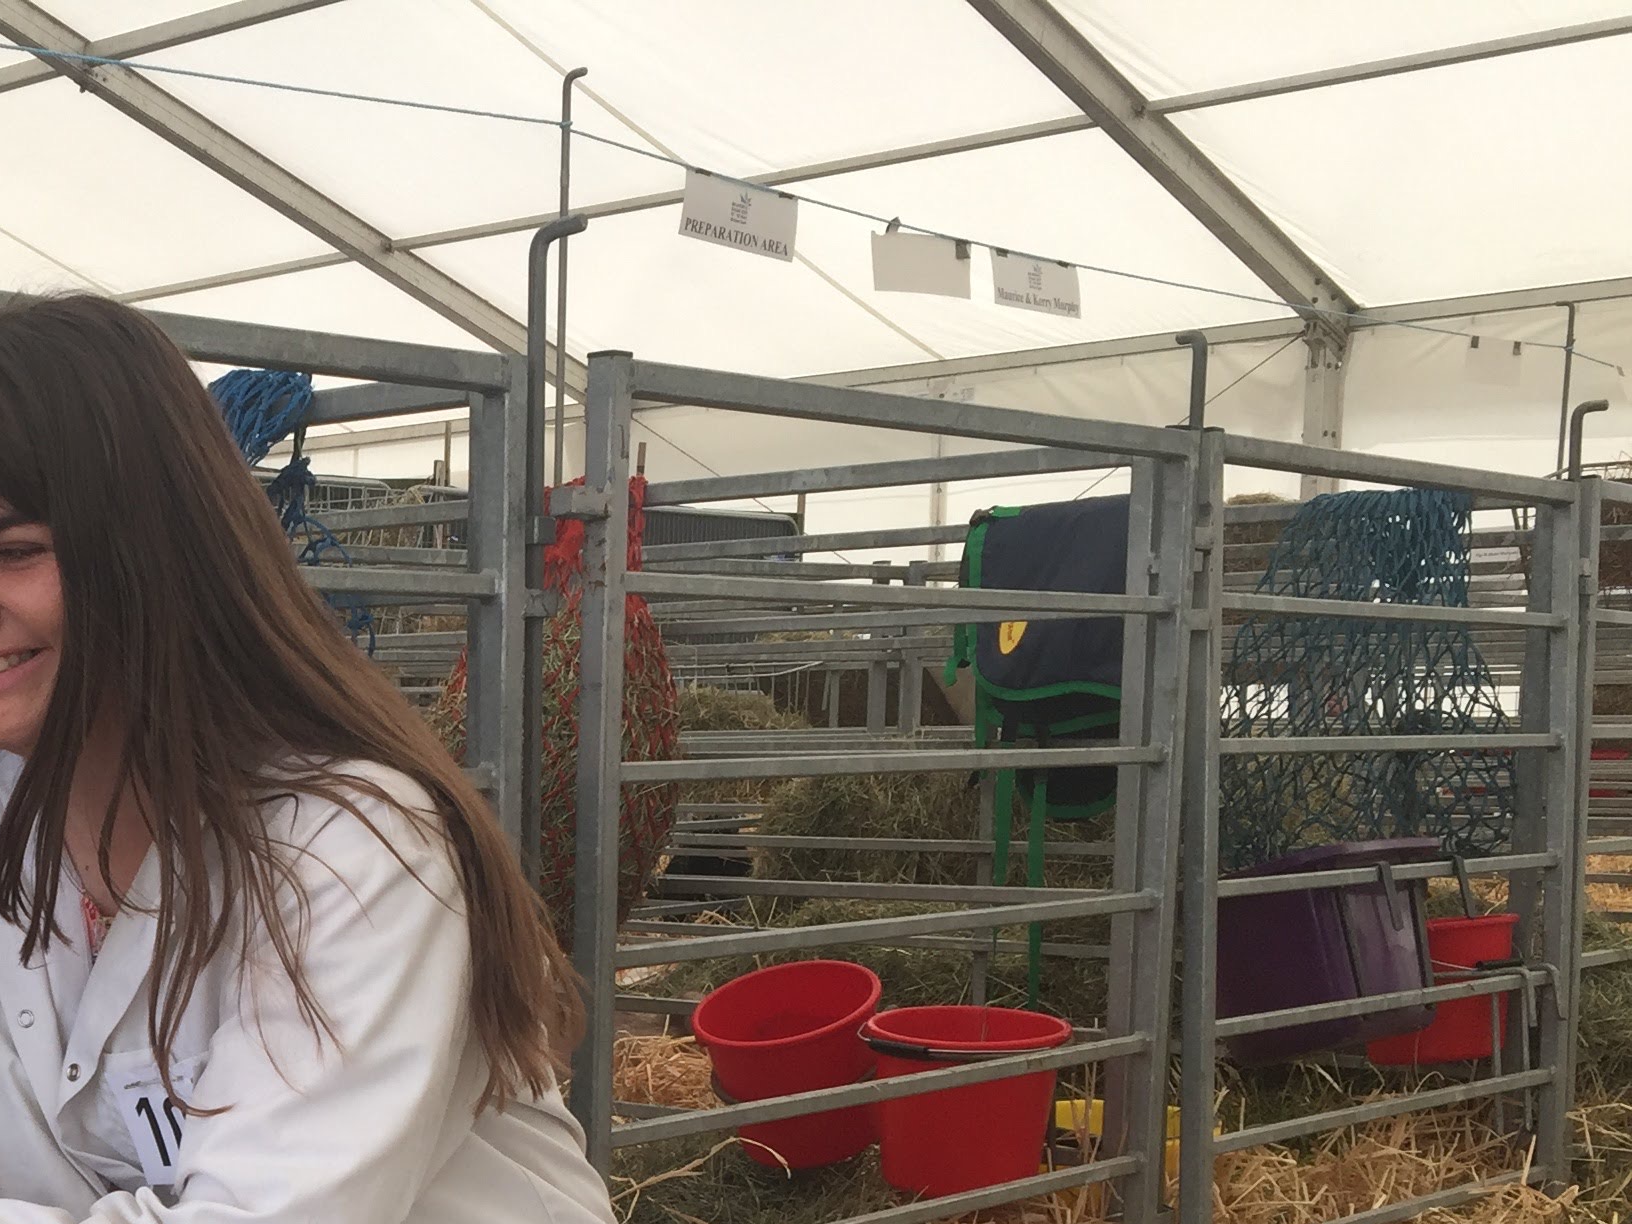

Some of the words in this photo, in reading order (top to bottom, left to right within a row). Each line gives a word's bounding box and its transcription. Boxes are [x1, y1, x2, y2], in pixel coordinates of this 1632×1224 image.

[684, 217, 759, 247] PREPARATION
[762, 239, 788, 256] AREA
[997, 287, 1024, 302] Maurice
[1025, 293, 1032, 305] &
[1033, 293, 1052, 308] Kerry
[1054, 297, 1079, 316] Murphy
